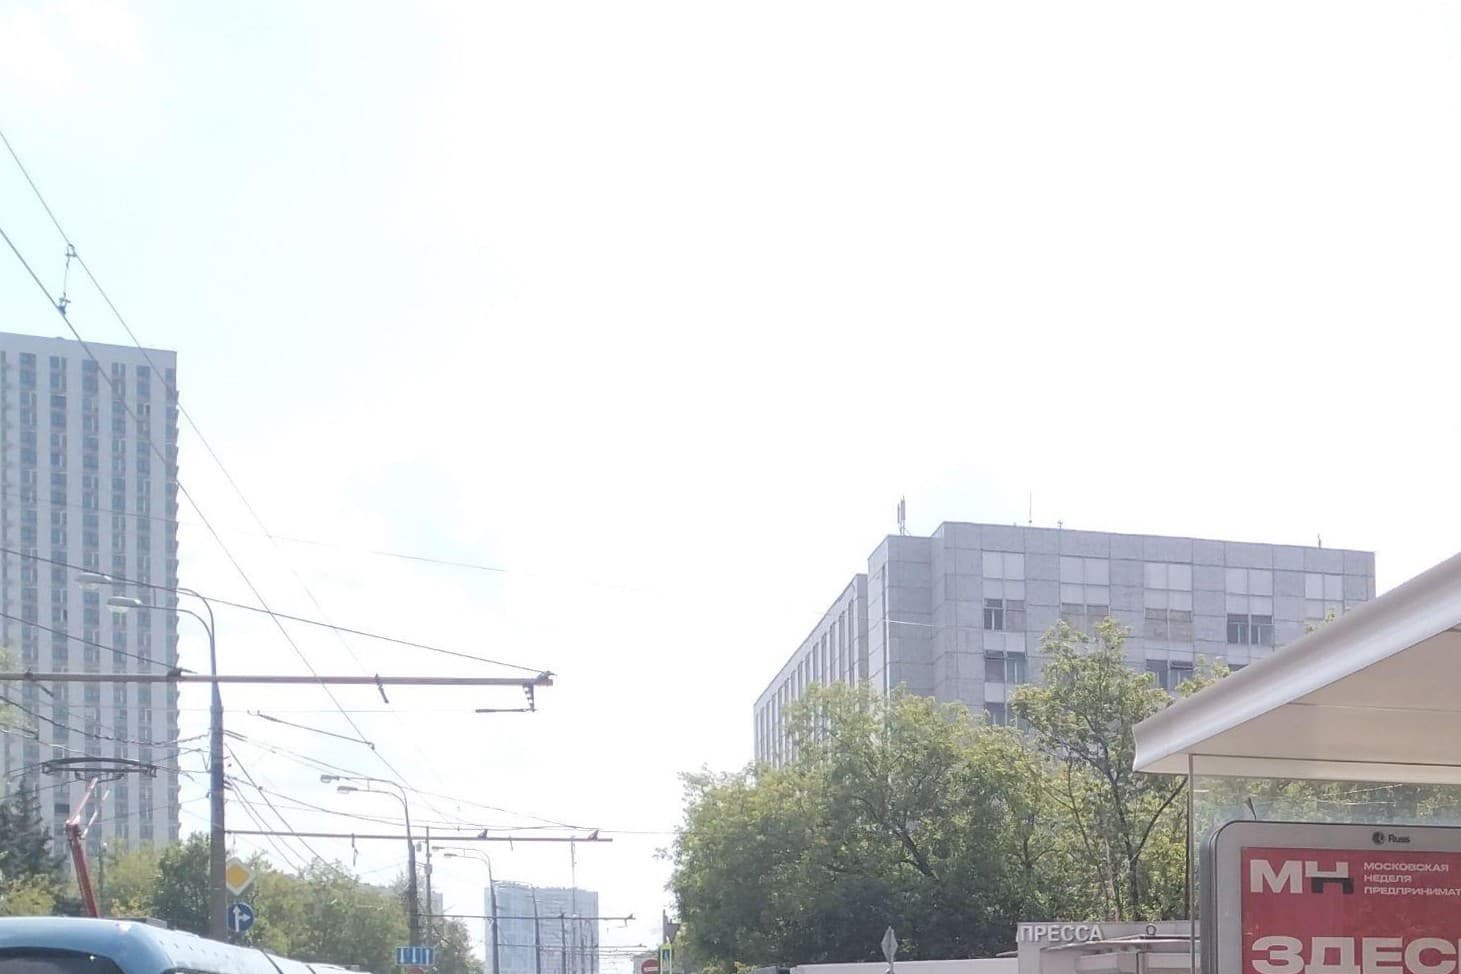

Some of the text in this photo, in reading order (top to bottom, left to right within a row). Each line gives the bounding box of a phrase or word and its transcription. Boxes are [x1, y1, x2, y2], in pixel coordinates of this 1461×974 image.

[1363, 861, 1449, 873] МОСКОВСКАЯ
[1363, 873, 1412, 884] НЕДЕЛЯ
[1018, 924, 1104, 943] ПРЕССА
